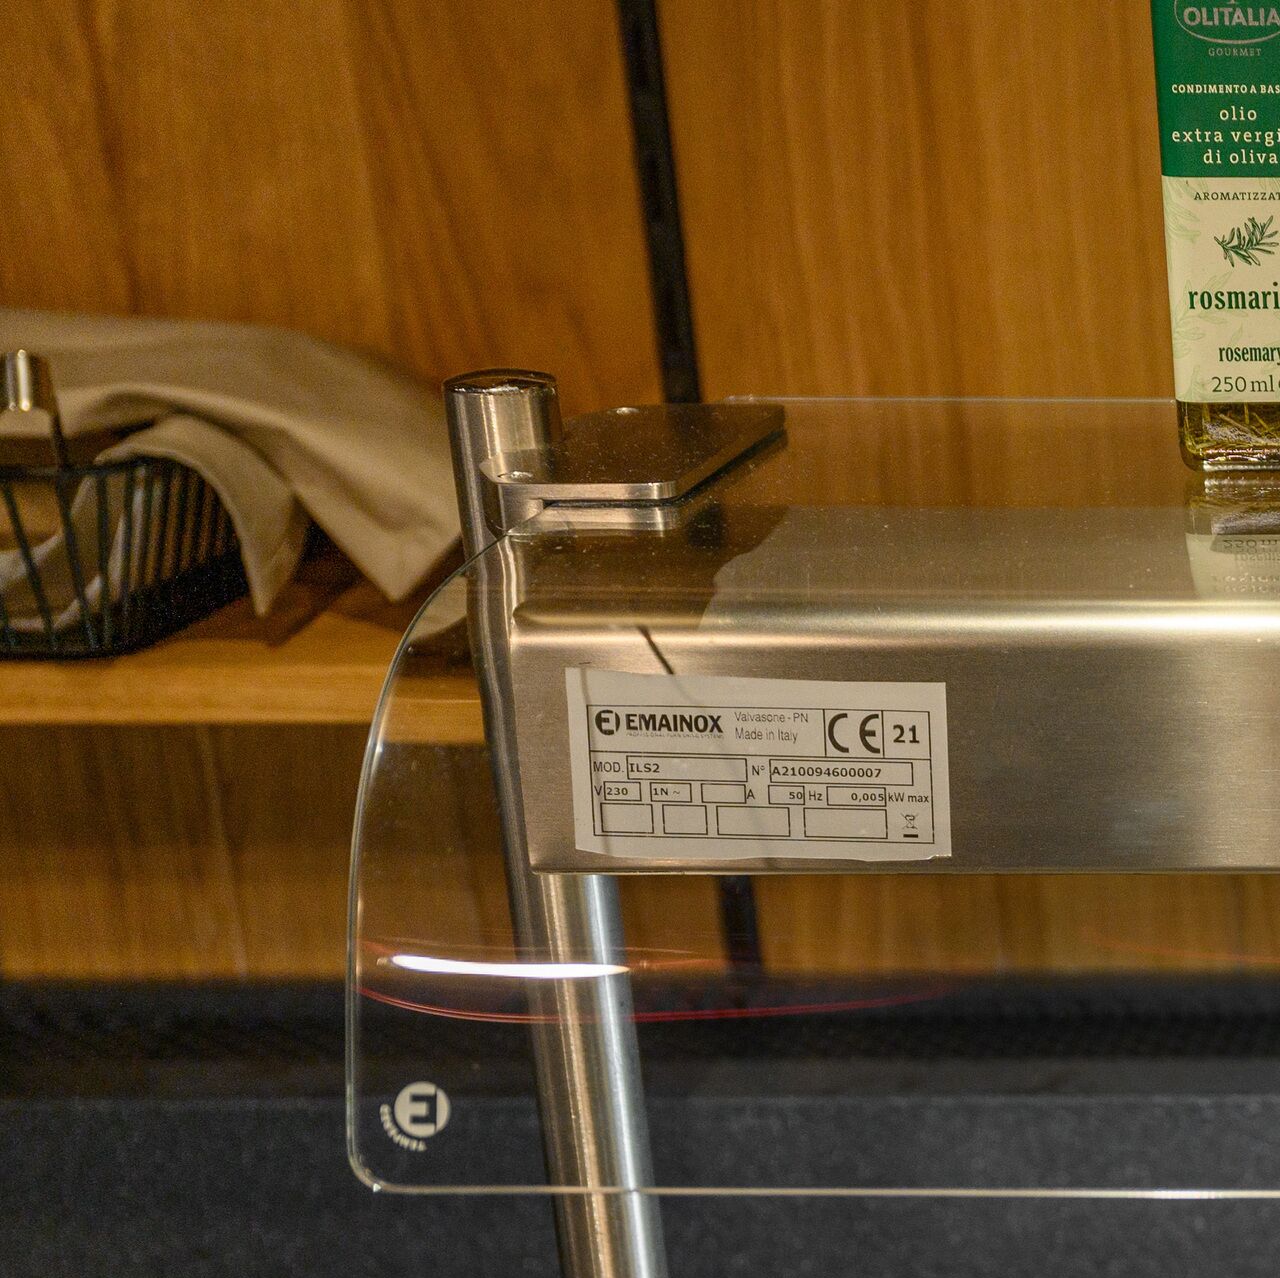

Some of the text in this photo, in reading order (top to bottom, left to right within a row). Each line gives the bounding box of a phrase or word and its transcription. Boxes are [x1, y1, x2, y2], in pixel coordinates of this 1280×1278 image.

[1208, 48, 1262, 57] GOURMET
[1172, 84, 1248, 94] CONDIMENTO
[1250, 85, 1257, 94] A
[1219, 106, 1257, 121] olio
[1171, 128, 1223, 143] extra
[1203, 149, 1279, 165] di oliva
[1211, 376, 1247, 393] 250
[1250, 375, 1275, 392] ml
[625, 714, 724, 733] EMAINOX
[734, 711, 785, 723] Valvasone
[793, 713, 809, 723] PN
[735, 728, 798, 744] Made in Italy
[893, 724, 920, 744] 21
[593, 761, 661, 773] MOD. ILS2
[771, 766, 882, 778] A210094600007
[594, 786, 603, 796] V
[606, 787, 629, 796] 230
[653, 788, 669, 796] 1N
[746, 789, 755, 799] A
[789, 791, 803, 800] 50
[808, 790, 822, 801] Hz
[851, 792, 884, 803] 0,005
[888, 791, 904, 802] kW
[907, 794, 930, 804] max
